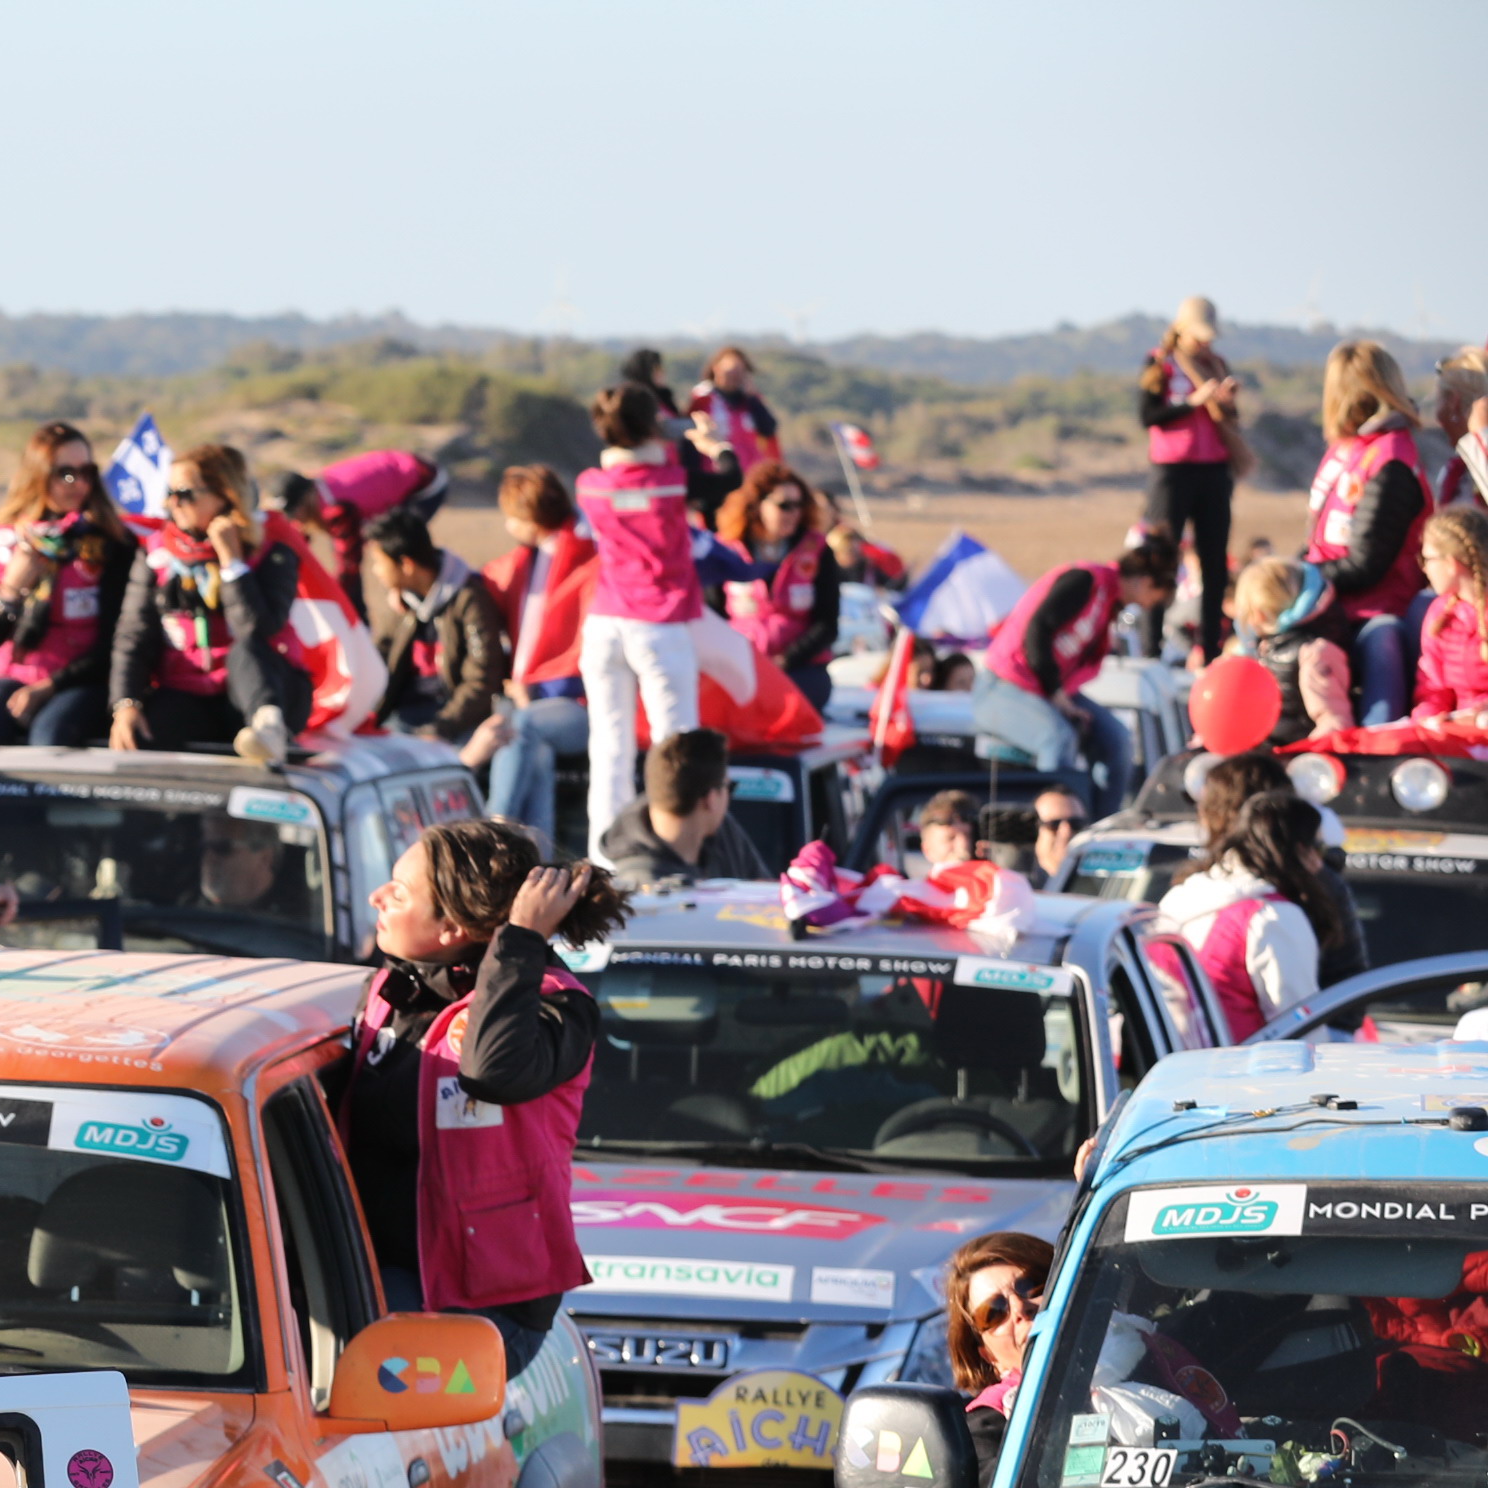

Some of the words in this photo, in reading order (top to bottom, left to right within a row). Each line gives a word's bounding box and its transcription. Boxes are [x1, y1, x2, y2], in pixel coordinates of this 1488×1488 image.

[712, 953, 782, 969] PARIS
[789, 954, 871, 971] MOTOR
[878, 958, 953, 976] SHOW
[83, 1123, 183, 1157] MDJS
[571, 1200, 861, 1231] SNCF
[1161, 1203, 1267, 1228] MDJS
[1309, 1201, 1455, 1222] MONDIAL
[587, 1338, 727, 1368] SUZU
[734, 1384, 826, 1411] RALLYE
[686, 1409, 834, 1467] AÏCH
[1104, 1448, 1173, 1487] 230
